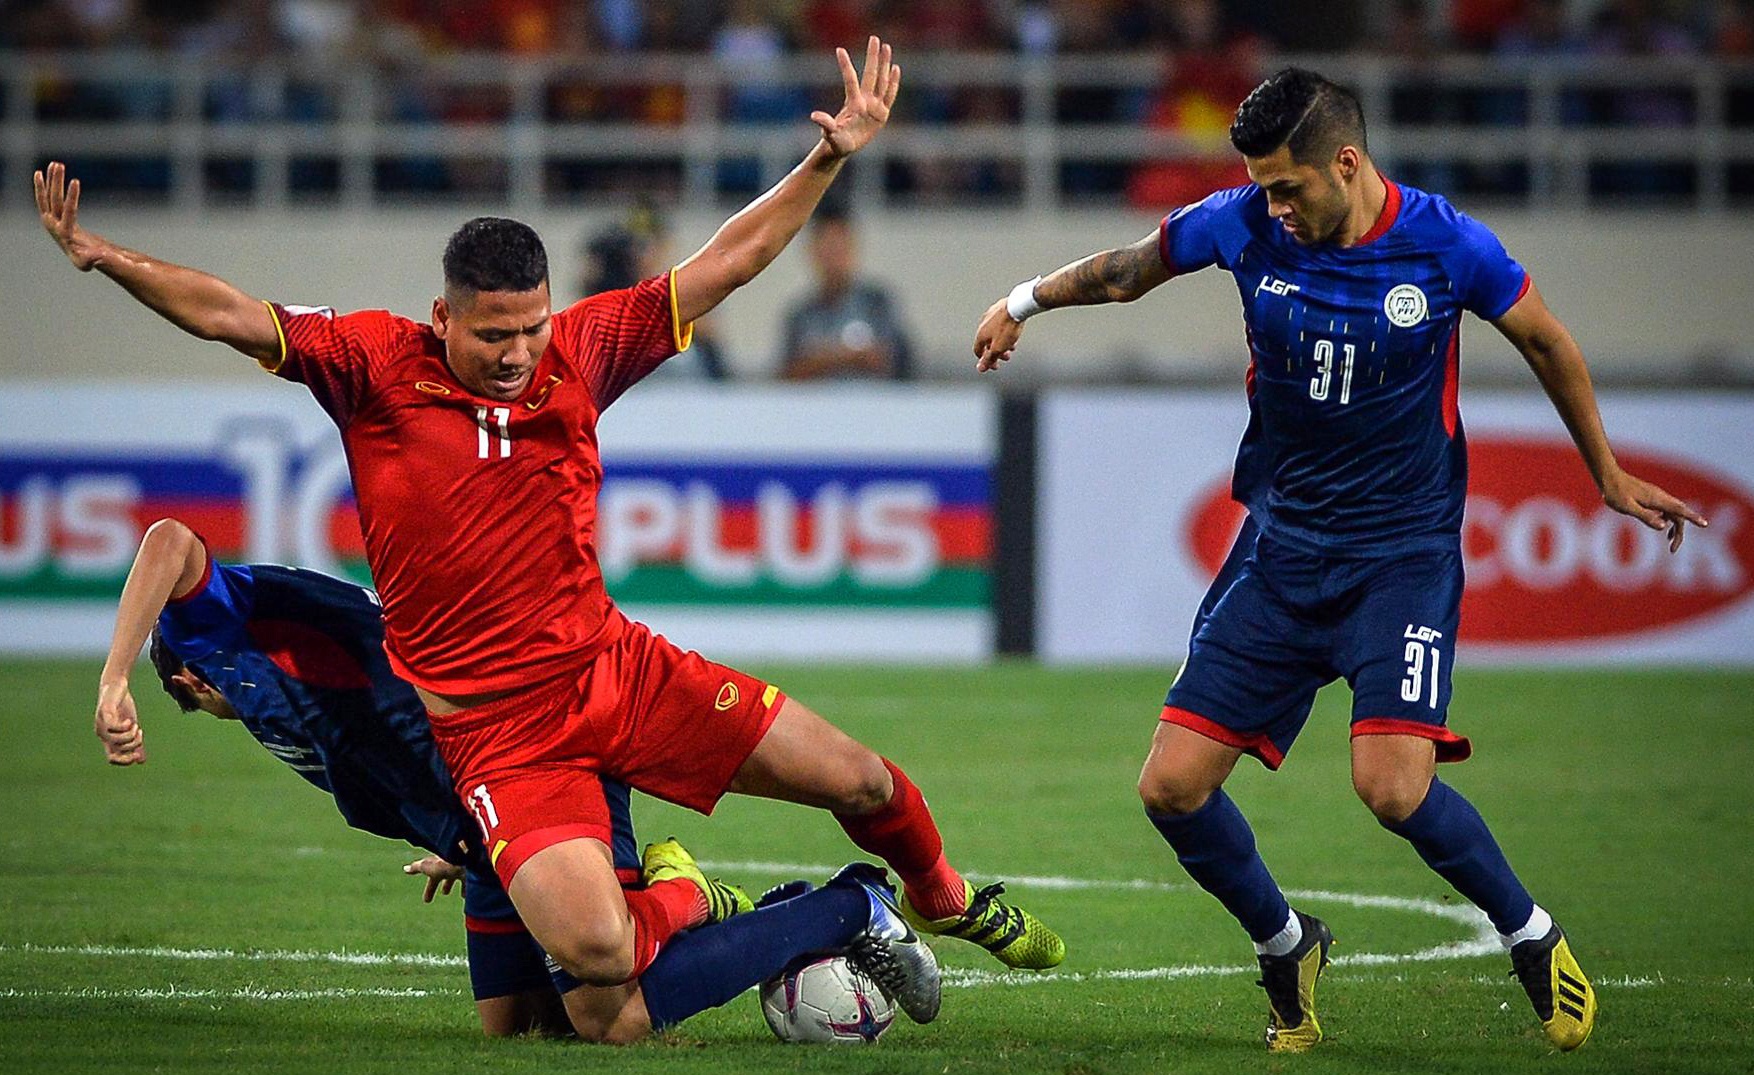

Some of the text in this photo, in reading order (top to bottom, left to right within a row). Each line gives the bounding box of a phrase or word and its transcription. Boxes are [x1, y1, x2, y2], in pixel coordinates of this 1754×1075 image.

[1310, 339, 1355, 404] 31
[475, 405, 512, 459] 11
[600, 479, 938, 586] PLUS
[1401, 641, 1440, 709] 31
